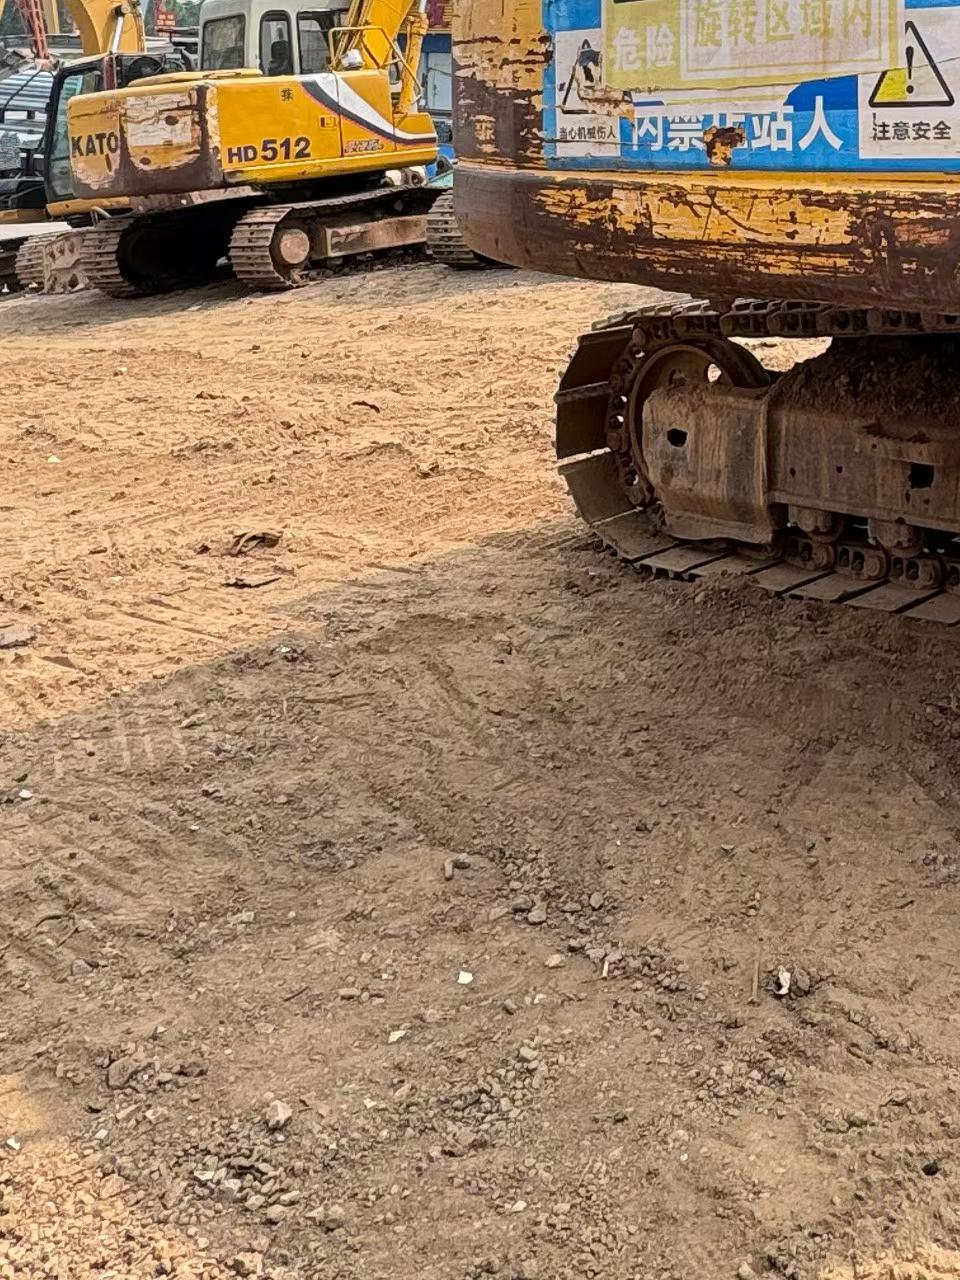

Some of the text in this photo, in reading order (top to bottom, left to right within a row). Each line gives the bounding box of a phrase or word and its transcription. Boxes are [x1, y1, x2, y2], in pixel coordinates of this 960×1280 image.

[613, 25, 676, 71] 危险
[872, 112, 952, 141] 注意安全
[71, 131, 119, 158] KATO
